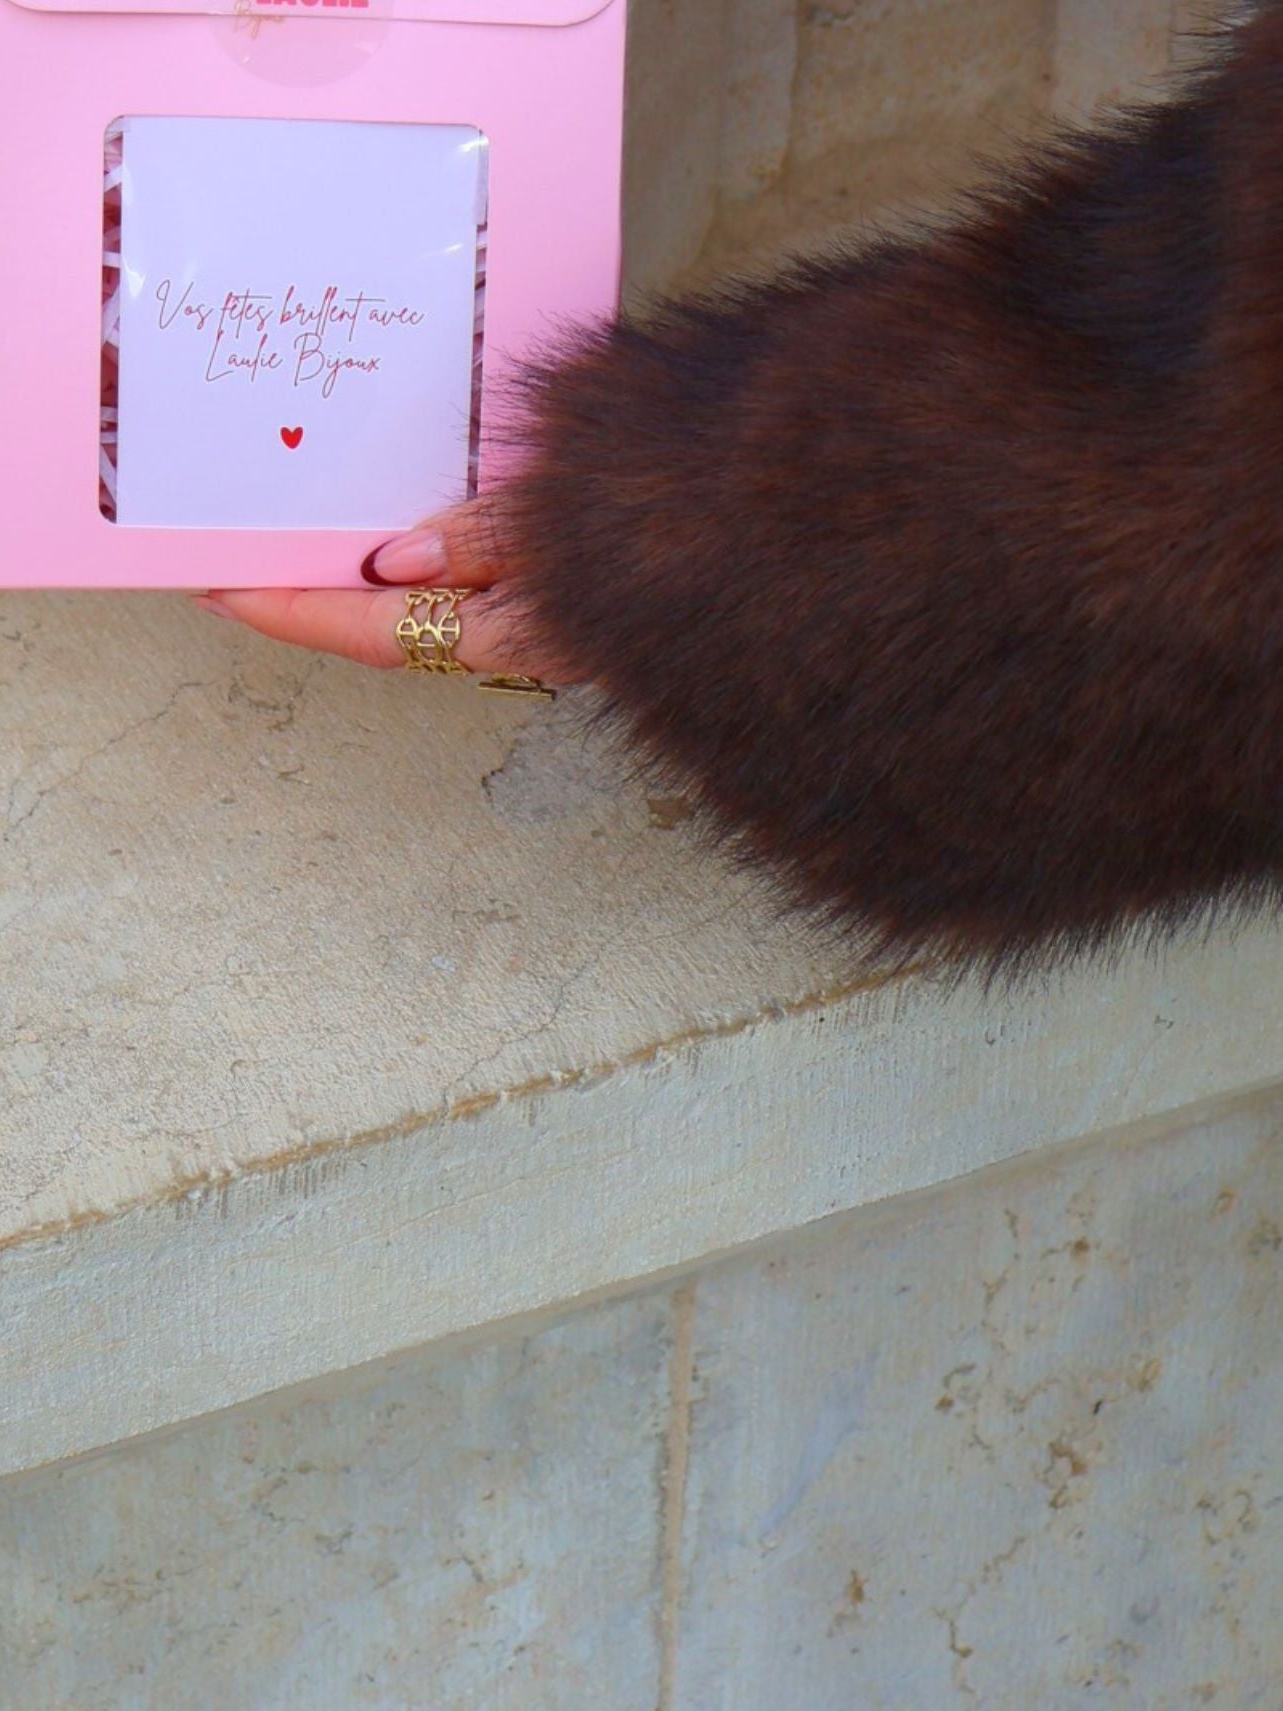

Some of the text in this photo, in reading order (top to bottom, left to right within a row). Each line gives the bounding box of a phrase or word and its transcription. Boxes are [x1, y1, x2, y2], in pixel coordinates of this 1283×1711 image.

[156, 279, 425, 341] Vos fêtes brillent avec
[205, 329, 380, 399] Laulie Bijoux
